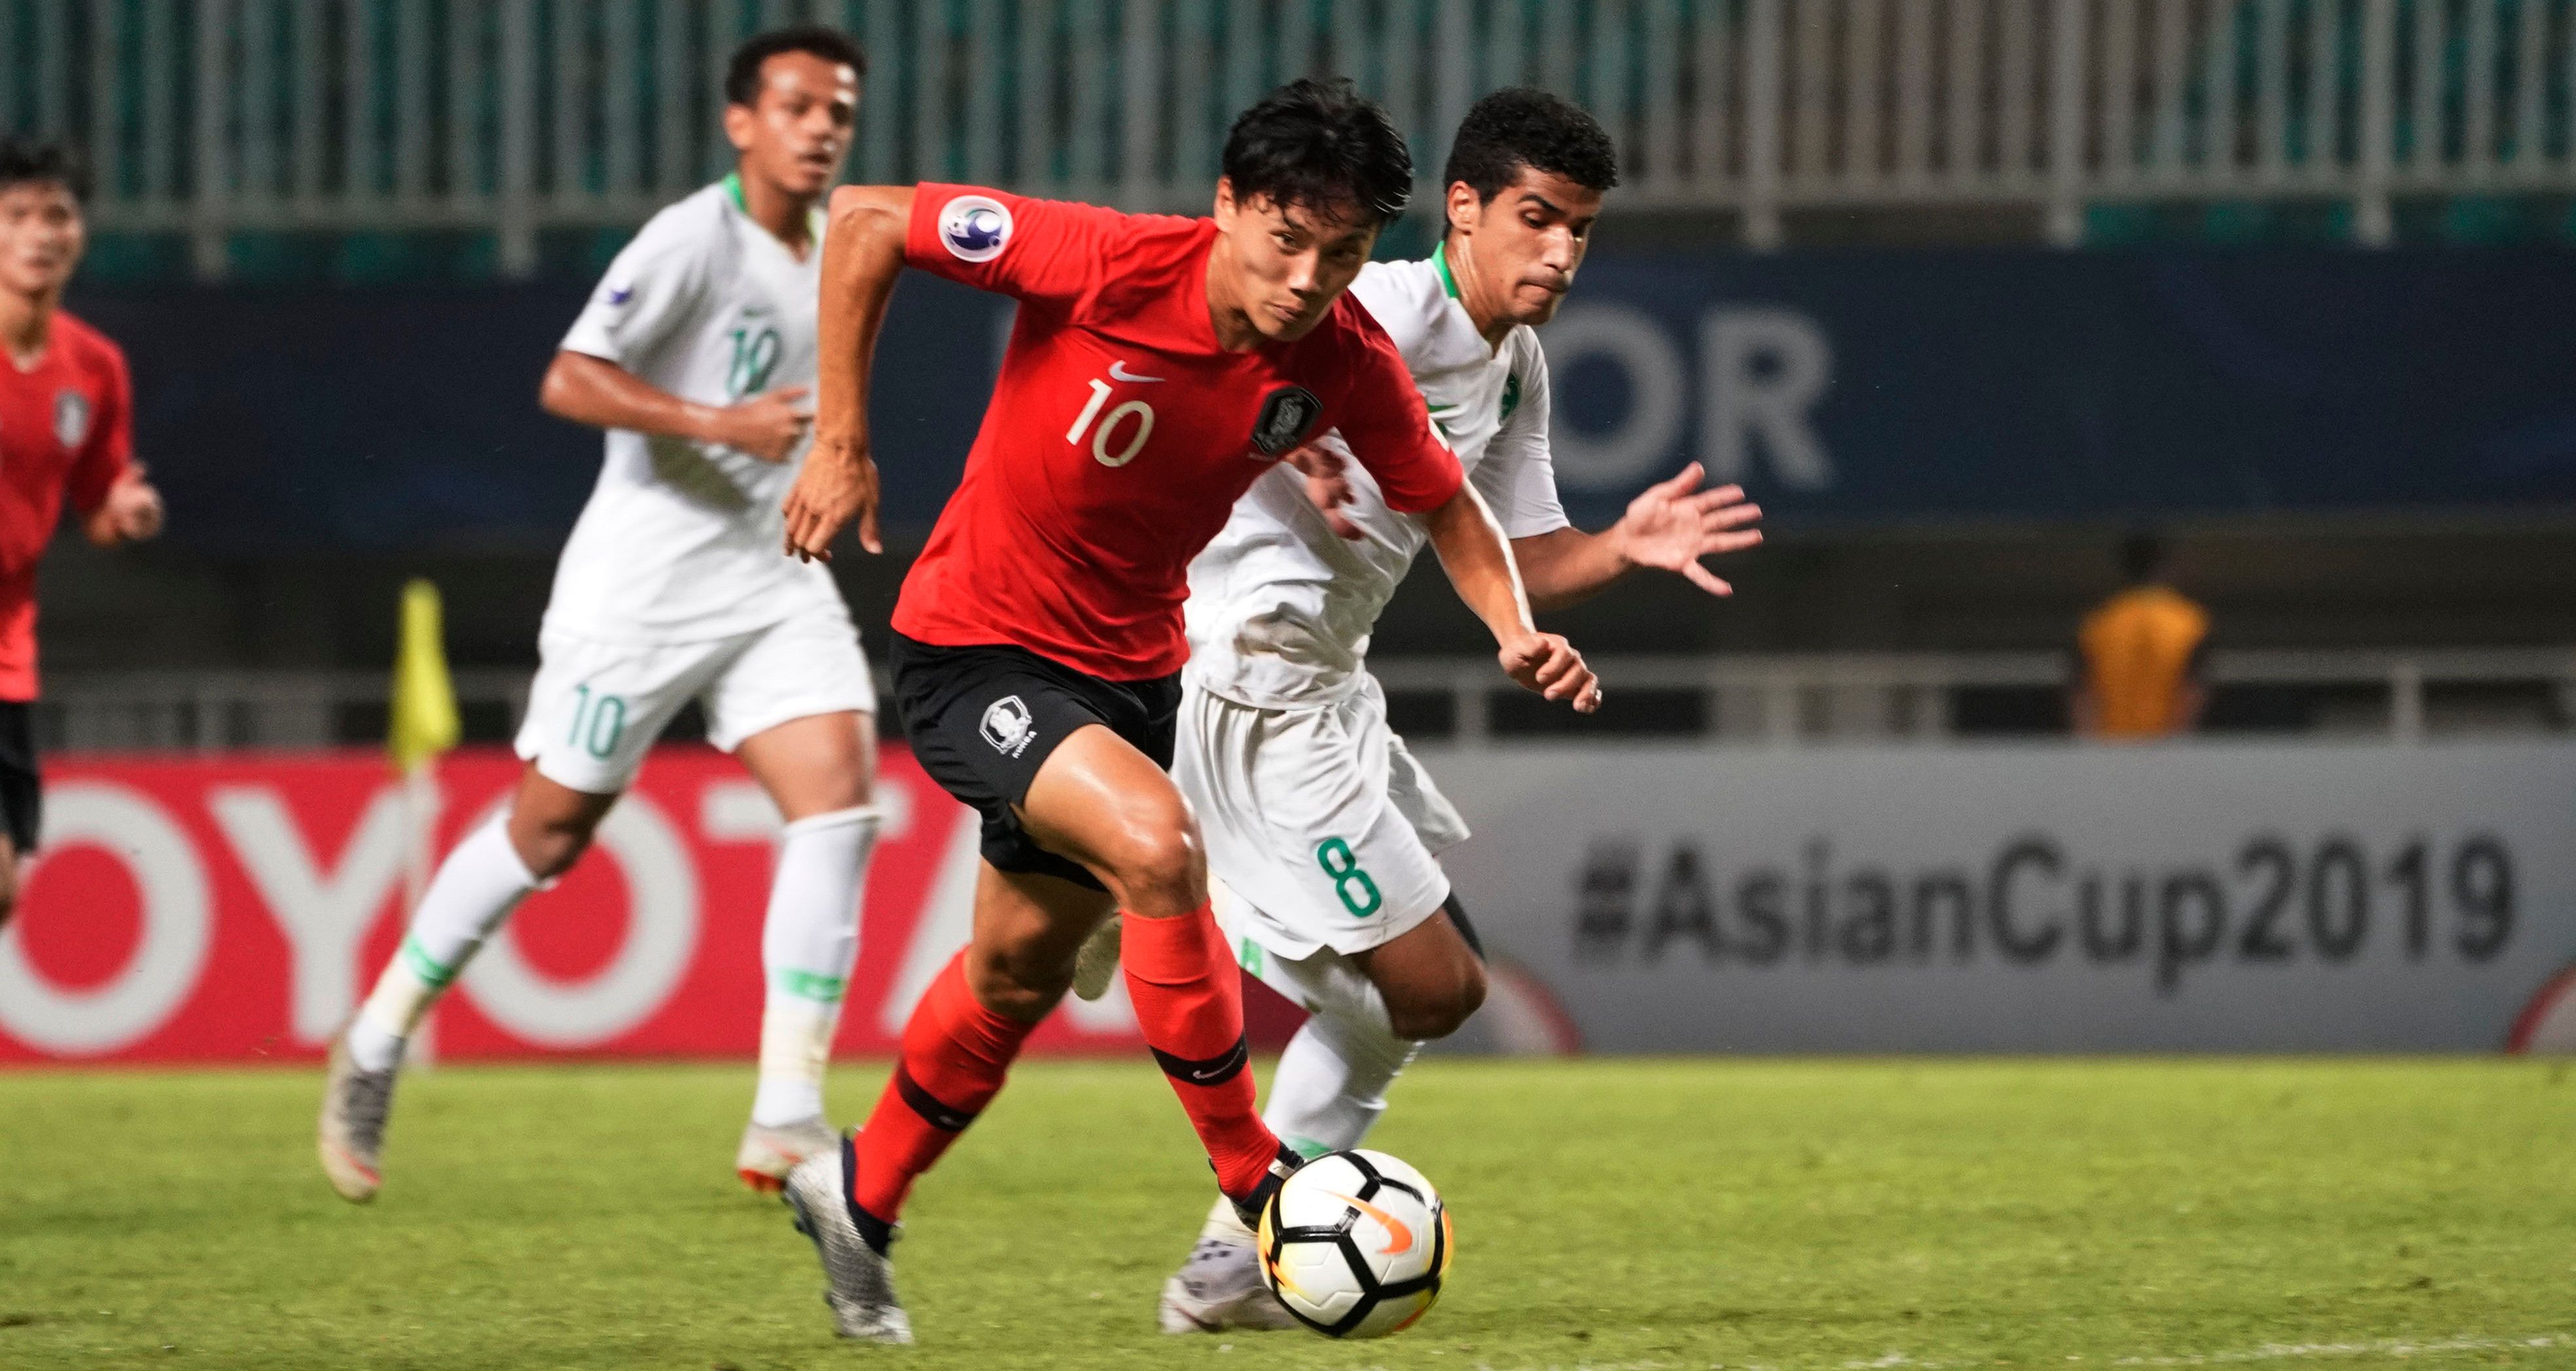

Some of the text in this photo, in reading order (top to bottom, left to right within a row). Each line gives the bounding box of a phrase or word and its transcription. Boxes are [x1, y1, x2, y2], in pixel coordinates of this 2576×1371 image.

[726, 327, 781, 398] 10
[1065, 378, 1154, 467] 10
[566, 682, 625, 761] 10
[1317, 836, 1382, 917] 8
[1571, 831, 2517, 996] #AsianCup2019
